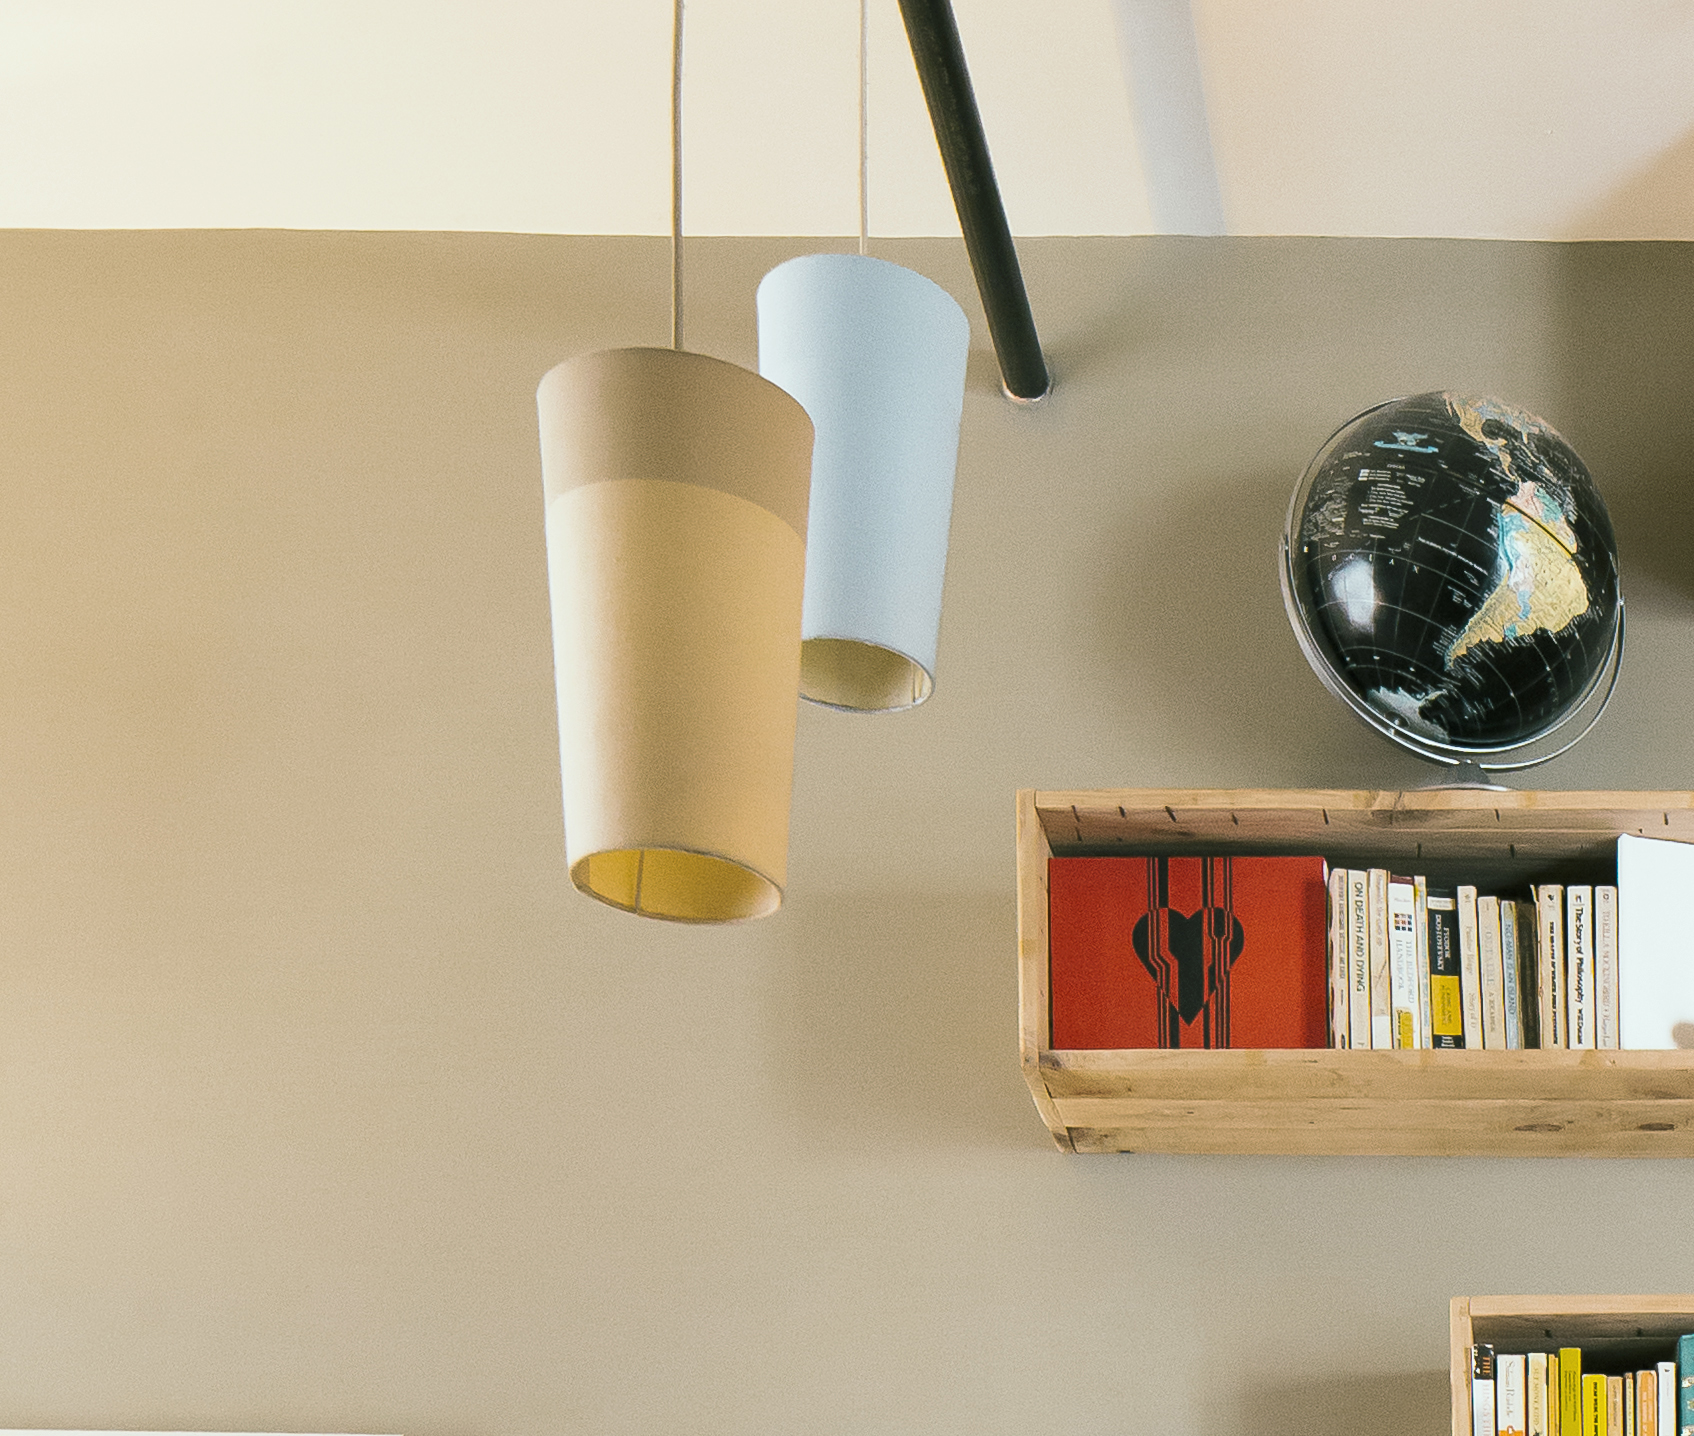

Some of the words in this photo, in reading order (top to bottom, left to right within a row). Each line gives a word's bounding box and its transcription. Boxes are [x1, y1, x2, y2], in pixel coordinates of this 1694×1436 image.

[1354, 882, 1363, 898] ON
[1355, 900, 1364, 933] DEATH
[1576, 908, 1584, 923] The
[1575, 924, 1584, 944] Story
[1356, 935, 1364, 957] AND
[1576, 946, 1584, 955] of
[1356, 959, 1365, 992] DYING
[1575, 957, 1584, 1003] Philosophy
